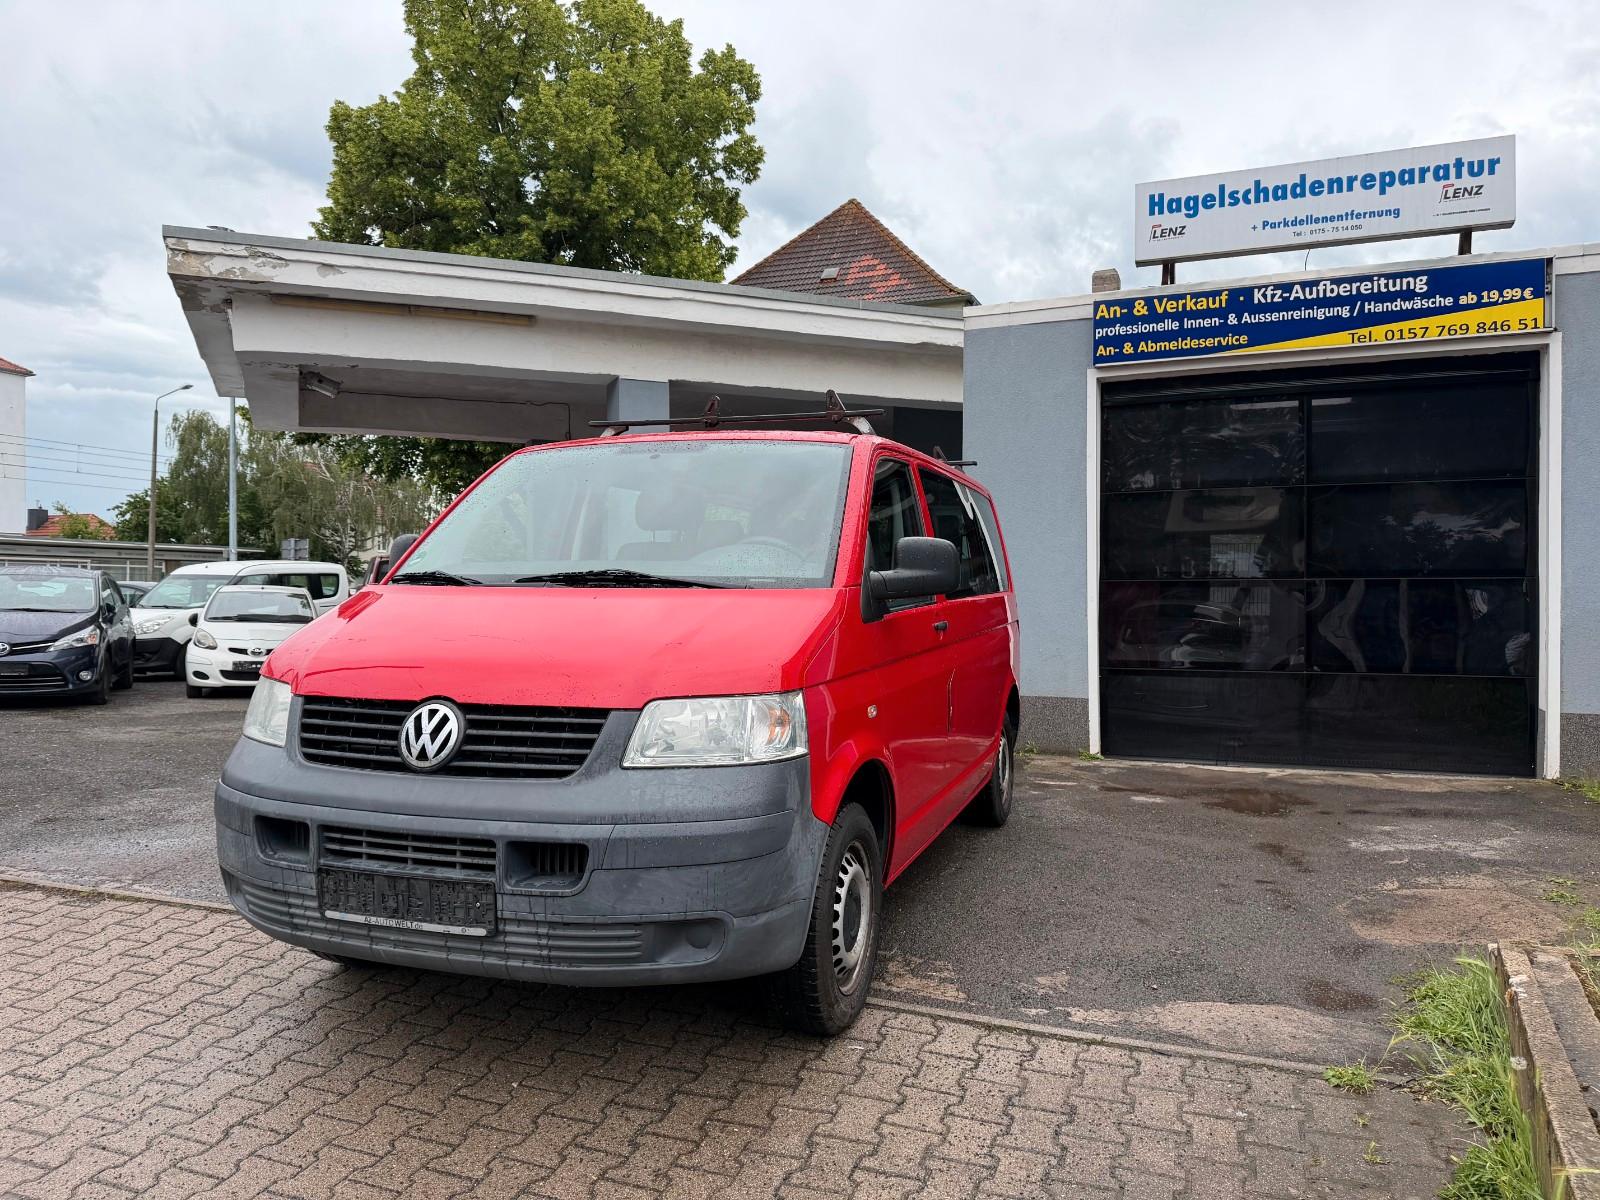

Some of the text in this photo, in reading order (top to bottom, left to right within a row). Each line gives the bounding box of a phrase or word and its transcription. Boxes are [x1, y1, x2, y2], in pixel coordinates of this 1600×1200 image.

[1148, 156, 1501, 219] Hagelschadenreparatur
[1443, 185, 1484, 200] LENZ
[1262, 207, 1401, 231] Parkdellenentfernung
[1152, 225, 1187, 239] LENZ
[1309, 228, 1326, 236] 0175
[1096, 275, 1428, 320] An- & Verkauf Kfz-Aufbereitung
[1095, 318, 1180, 340] professionelle
[1184, 316, 1224, 329] Innen-
[1227, 313, 1238, 325] &
[1241, 305, 1351, 324] Aussenreinigung
[1353, 301, 1361, 317] /
[1364, 294, 1454, 313] Handwäsche
[1459, 291, 1477, 305] ab
[1348, 317, 1541, 344] Tel. 0157 769 846 51
[1096, 333, 1249, 357] An- & Abmeldeservice
